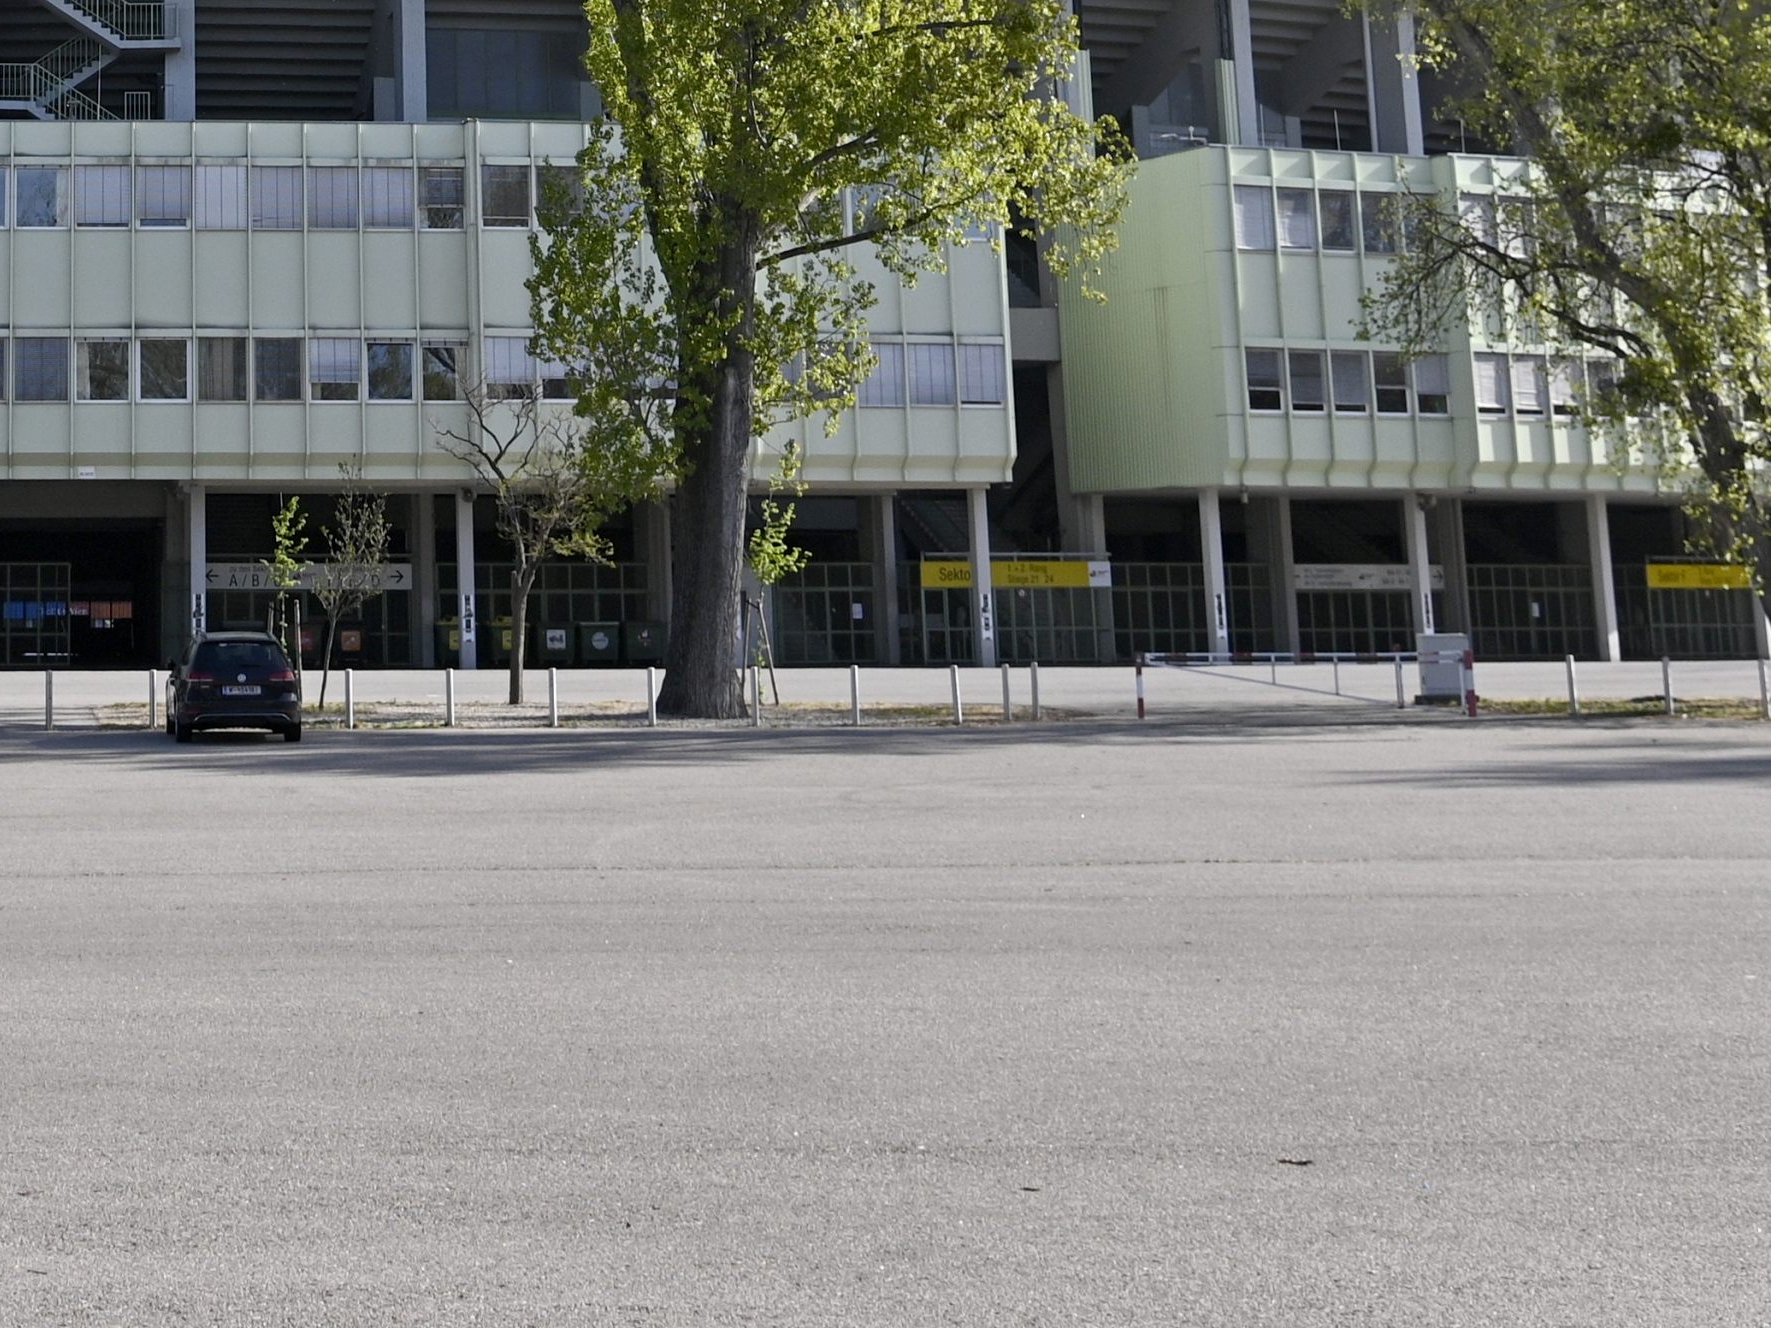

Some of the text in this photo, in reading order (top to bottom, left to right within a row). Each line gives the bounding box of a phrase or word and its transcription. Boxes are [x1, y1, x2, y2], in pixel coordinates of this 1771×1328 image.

[229, 574, 238, 587] A
[252, 574, 260, 587] B
[938, 567, 971, 582] Sekto
